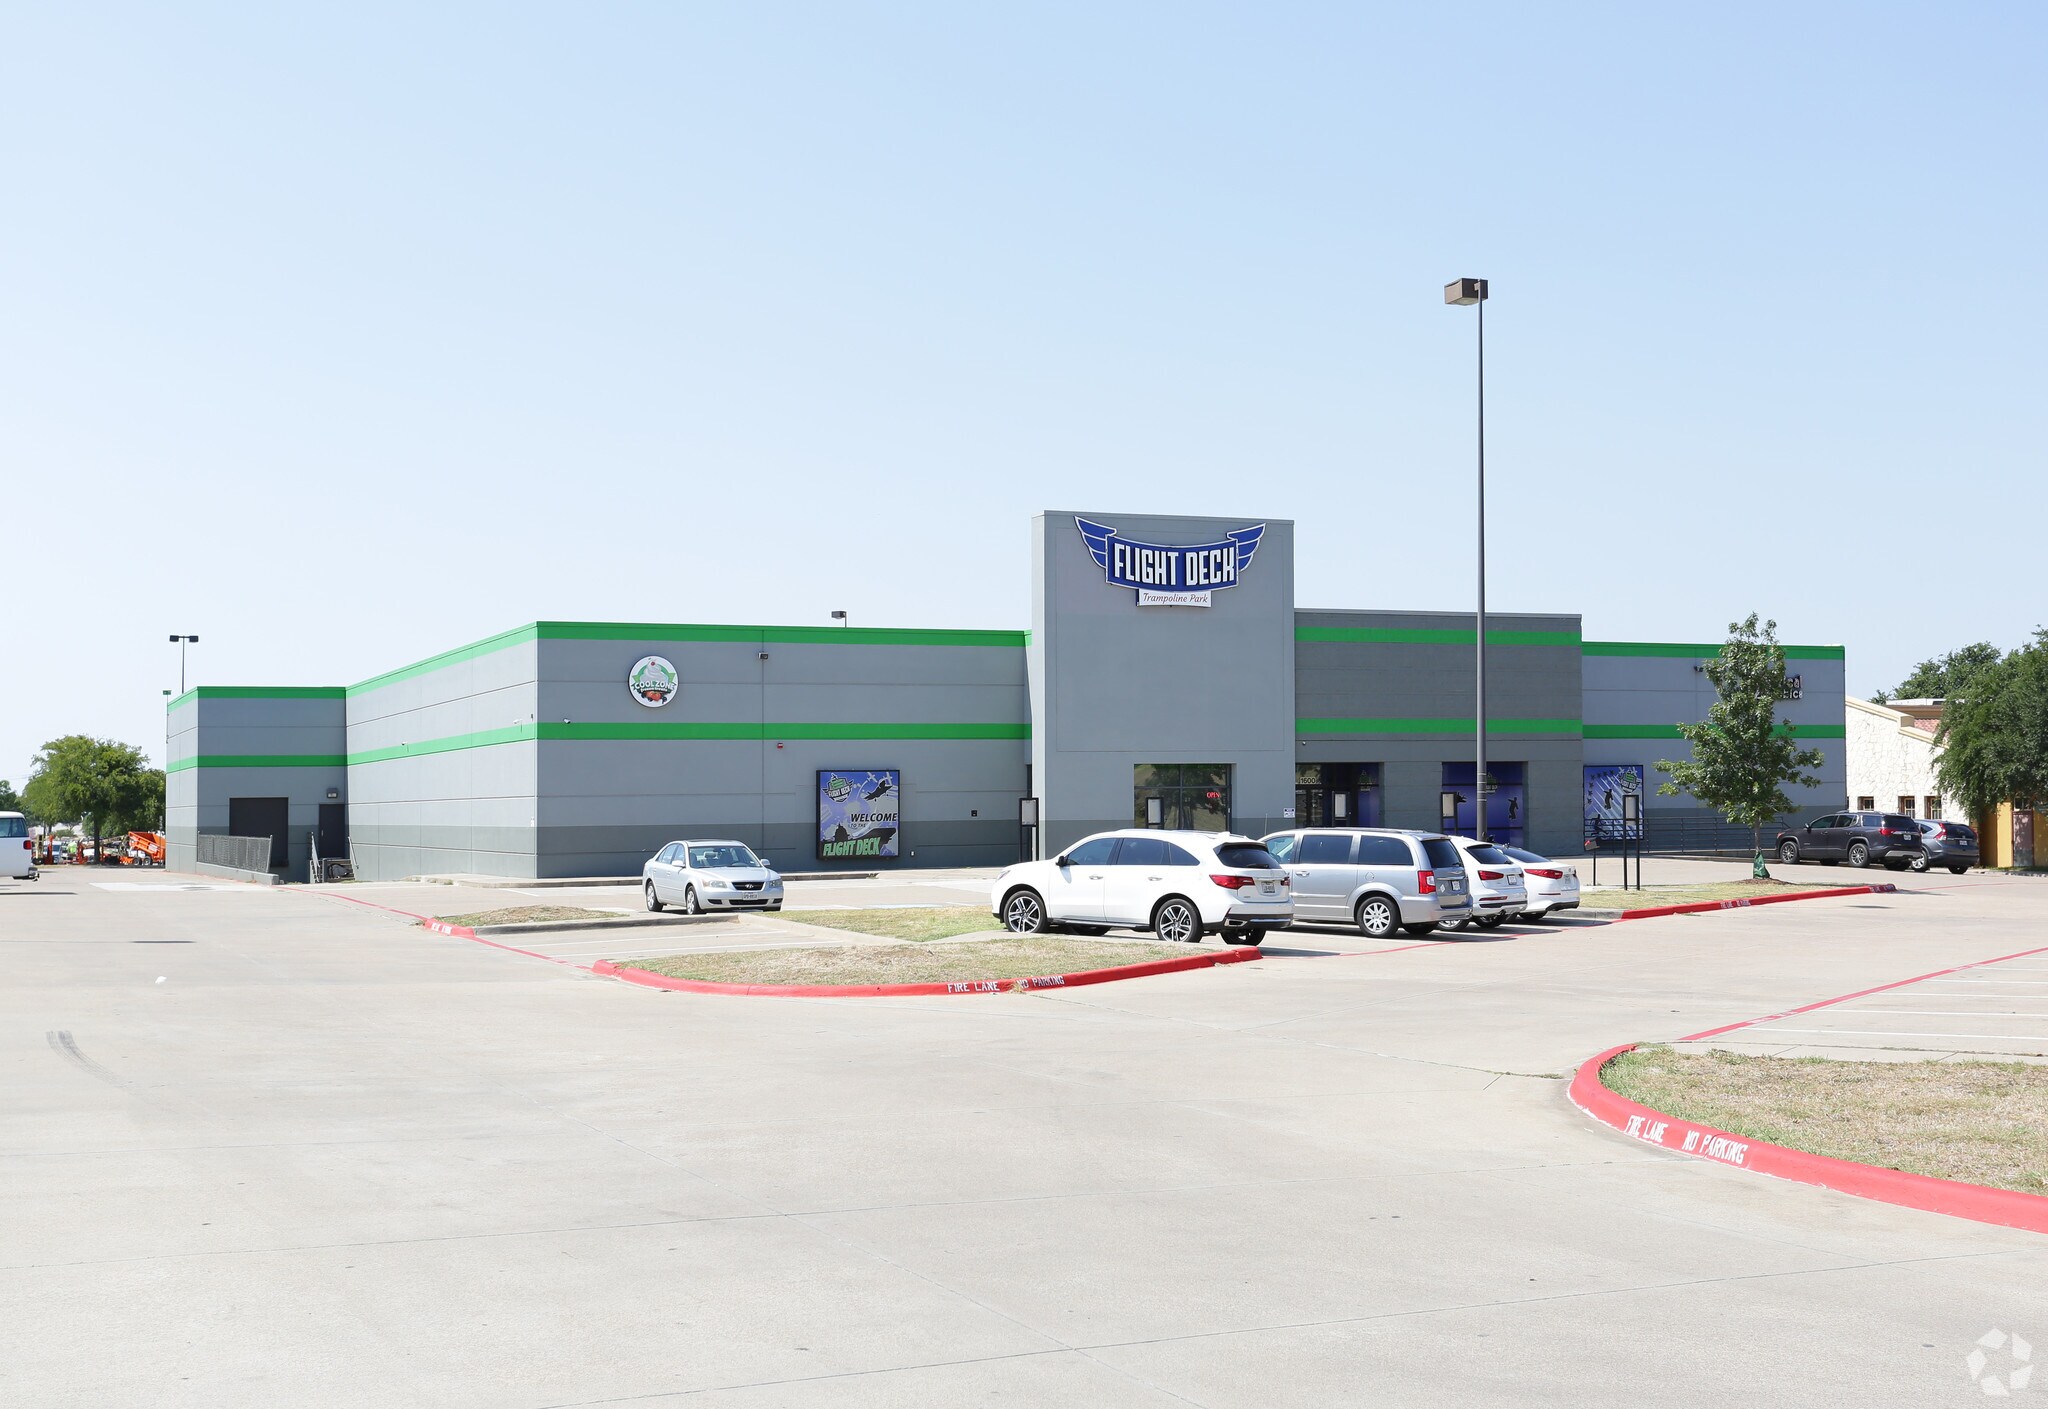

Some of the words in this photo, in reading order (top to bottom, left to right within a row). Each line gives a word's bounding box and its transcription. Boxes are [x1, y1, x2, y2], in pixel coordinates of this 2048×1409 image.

[1114, 543, 1179, 586] FLIGHT
[1185, 546, 1235, 586] DECK
[1143, 592, 1188, 604] Trampoline
[1189, 593, 1208, 603] Park
[635, 680, 654, 689] COOL
[655, 680, 675, 691] ZONE
[851, 813, 897, 822] WELCOME
[823, 840, 855, 856] FLIGHT
[856, 837, 881, 855] DECK
[947, 982, 970, 993] FIRE
[974, 981, 1000, 991] LANE
[1017, 979, 1029, 989] NO
[1032, 975, 1065, 987] PARKING
[1624, 1115, 1646, 1137] FIRE
[1643, 1120, 1669, 1143] LANE
[1681, 1130, 1700, 1151] NO
[1699, 1134, 1749, 1165] PARKING
